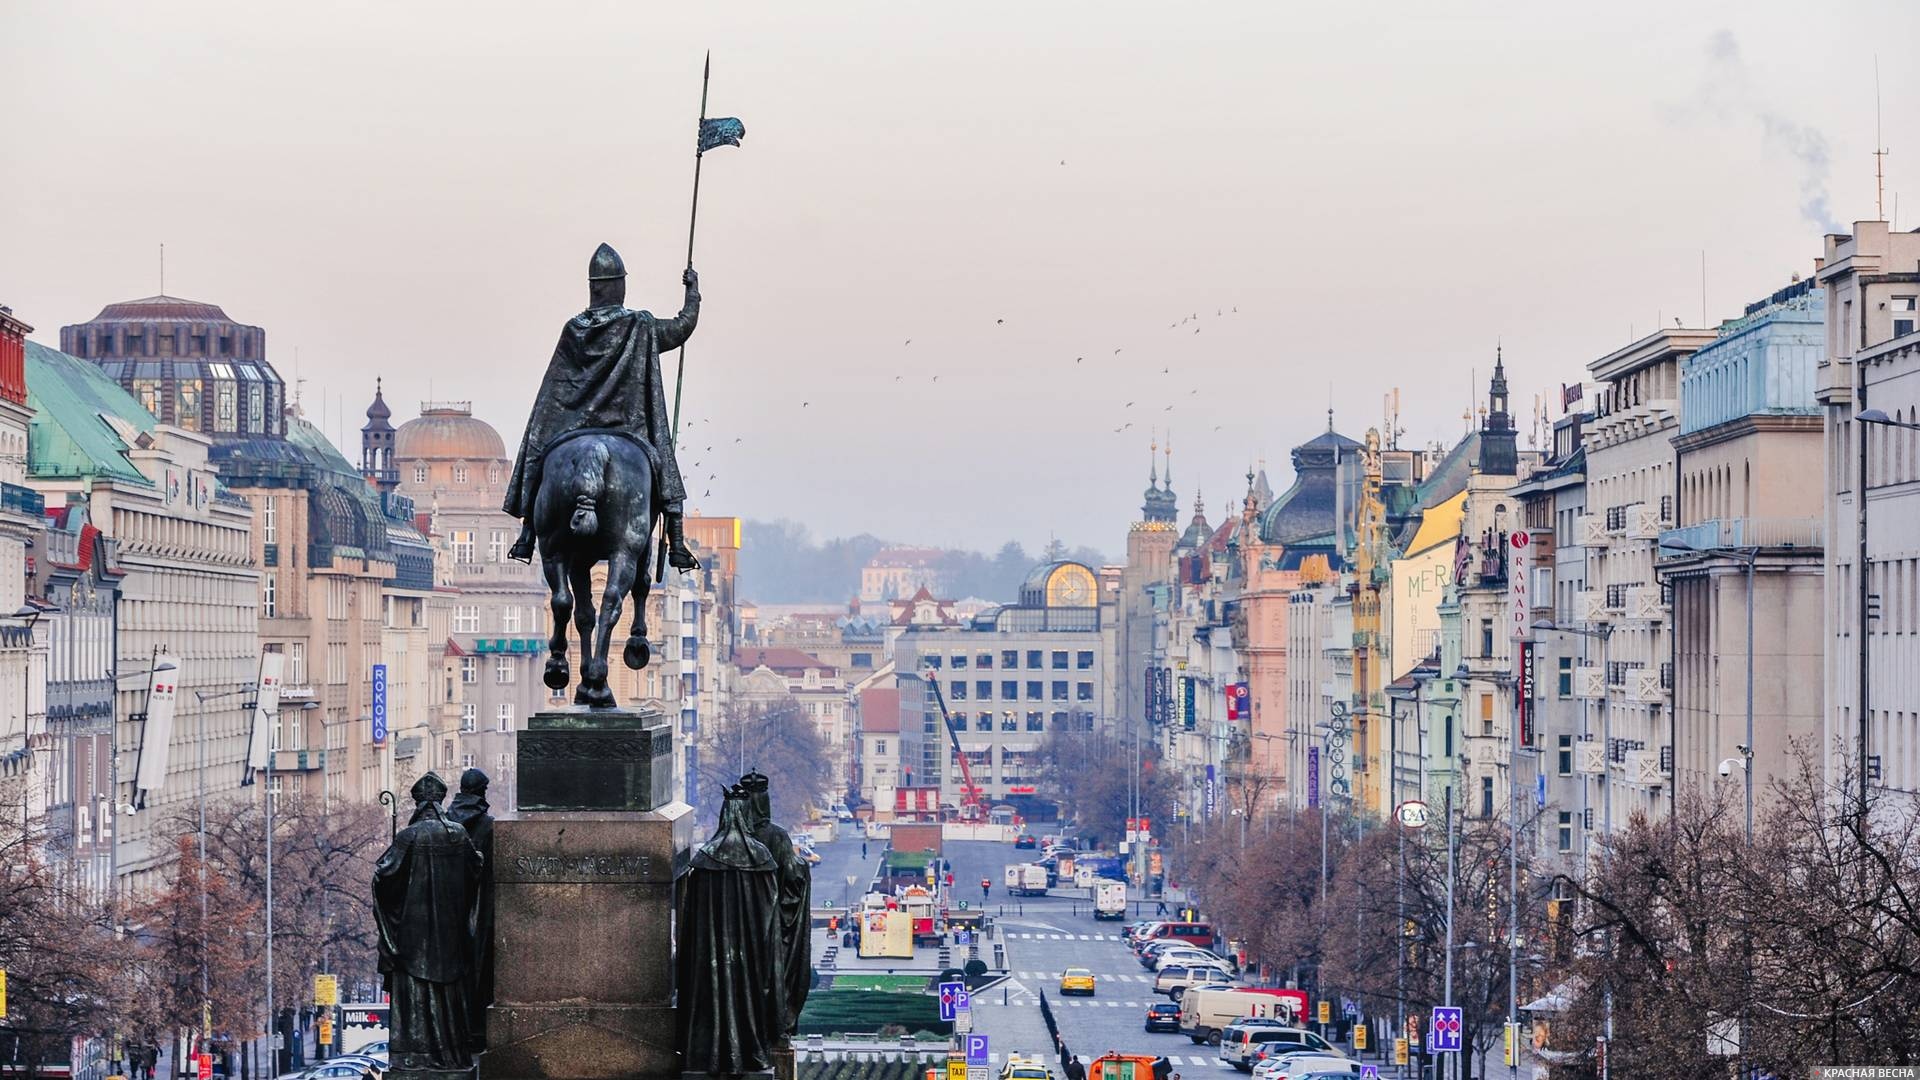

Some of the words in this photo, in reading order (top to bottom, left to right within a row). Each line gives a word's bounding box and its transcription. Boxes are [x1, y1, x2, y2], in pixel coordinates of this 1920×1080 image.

[1514, 556, 1525, 636] RAMADA
[375, 669, 384, 739] ROKOKO
[1155, 670, 1163, 721] CASINO
[1402, 808, 1425, 821] C&A
[958, 994, 967, 1006] P
[970, 1038, 984, 1057] P
[952, 1068, 966, 1076] TAXI
